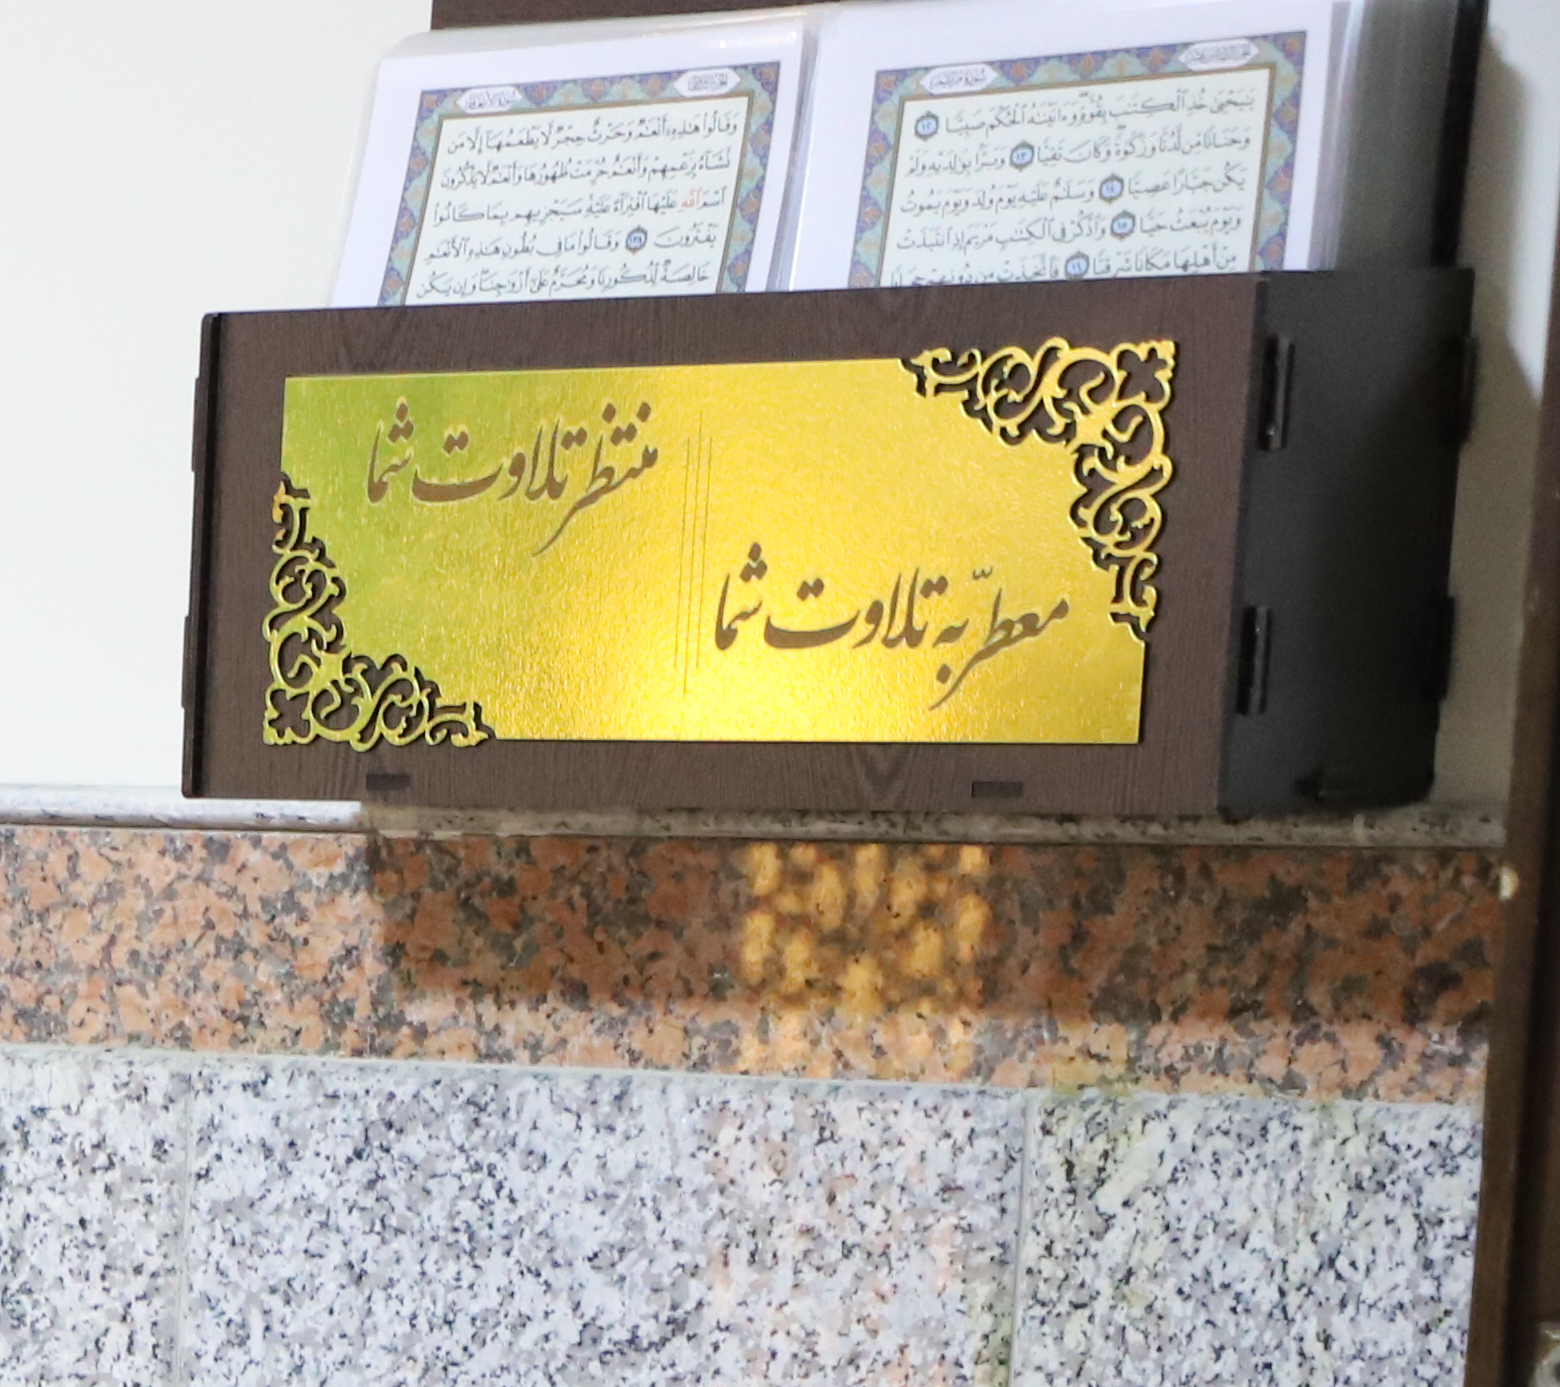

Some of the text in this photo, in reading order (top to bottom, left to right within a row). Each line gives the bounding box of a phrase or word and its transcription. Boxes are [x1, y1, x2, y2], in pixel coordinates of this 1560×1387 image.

[367, 399, 658, 558] منتظر تلاوت شما
[715, 542, 768, 650] شما
[764, 567, 948, 650] تلاوت
[933, 618, 969, 684] به
